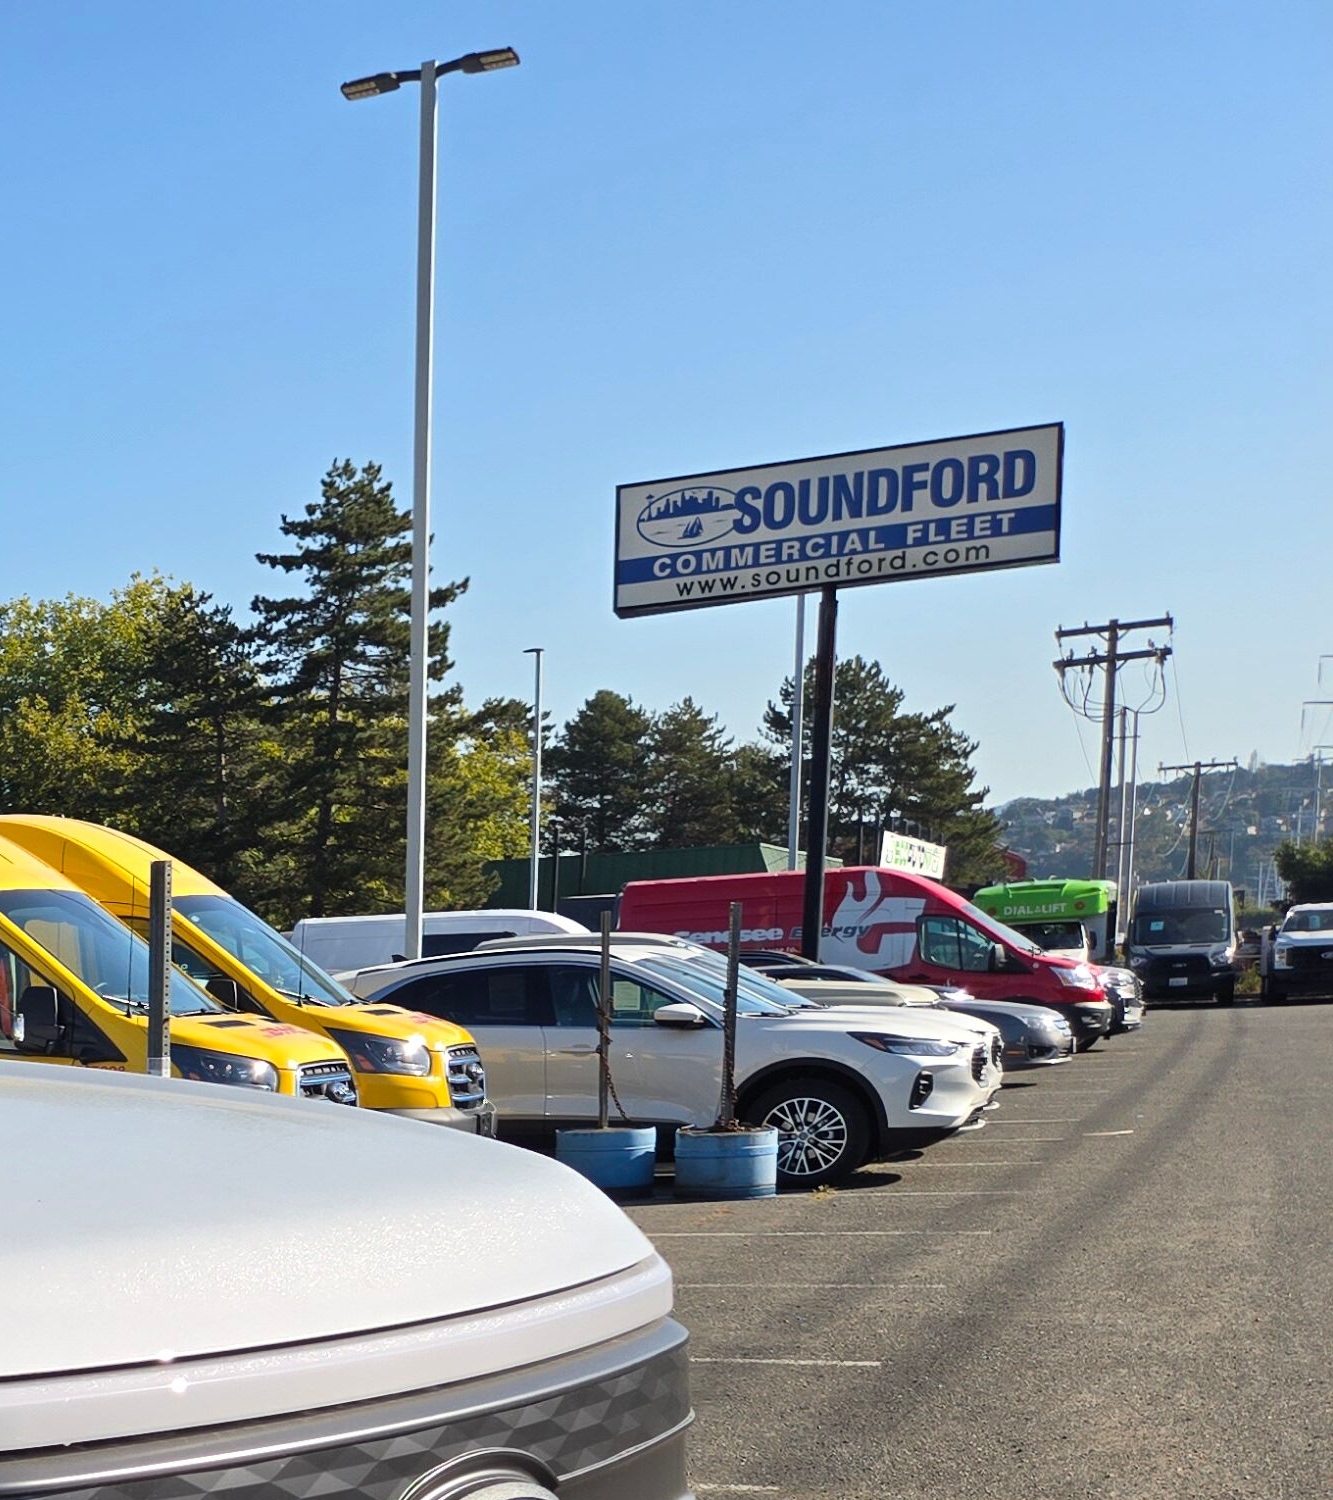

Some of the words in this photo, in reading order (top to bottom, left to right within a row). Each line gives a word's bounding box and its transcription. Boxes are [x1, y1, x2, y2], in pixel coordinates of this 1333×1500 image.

[733, 449, 1037, 535] SOUNDFORD
[652, 527, 885, 578] COMMERCIAL
[906, 512, 1017, 548] FLEET
[675, 541, 991, 597] www.soundford.com
[789, 926, 871, 939] Eergy
